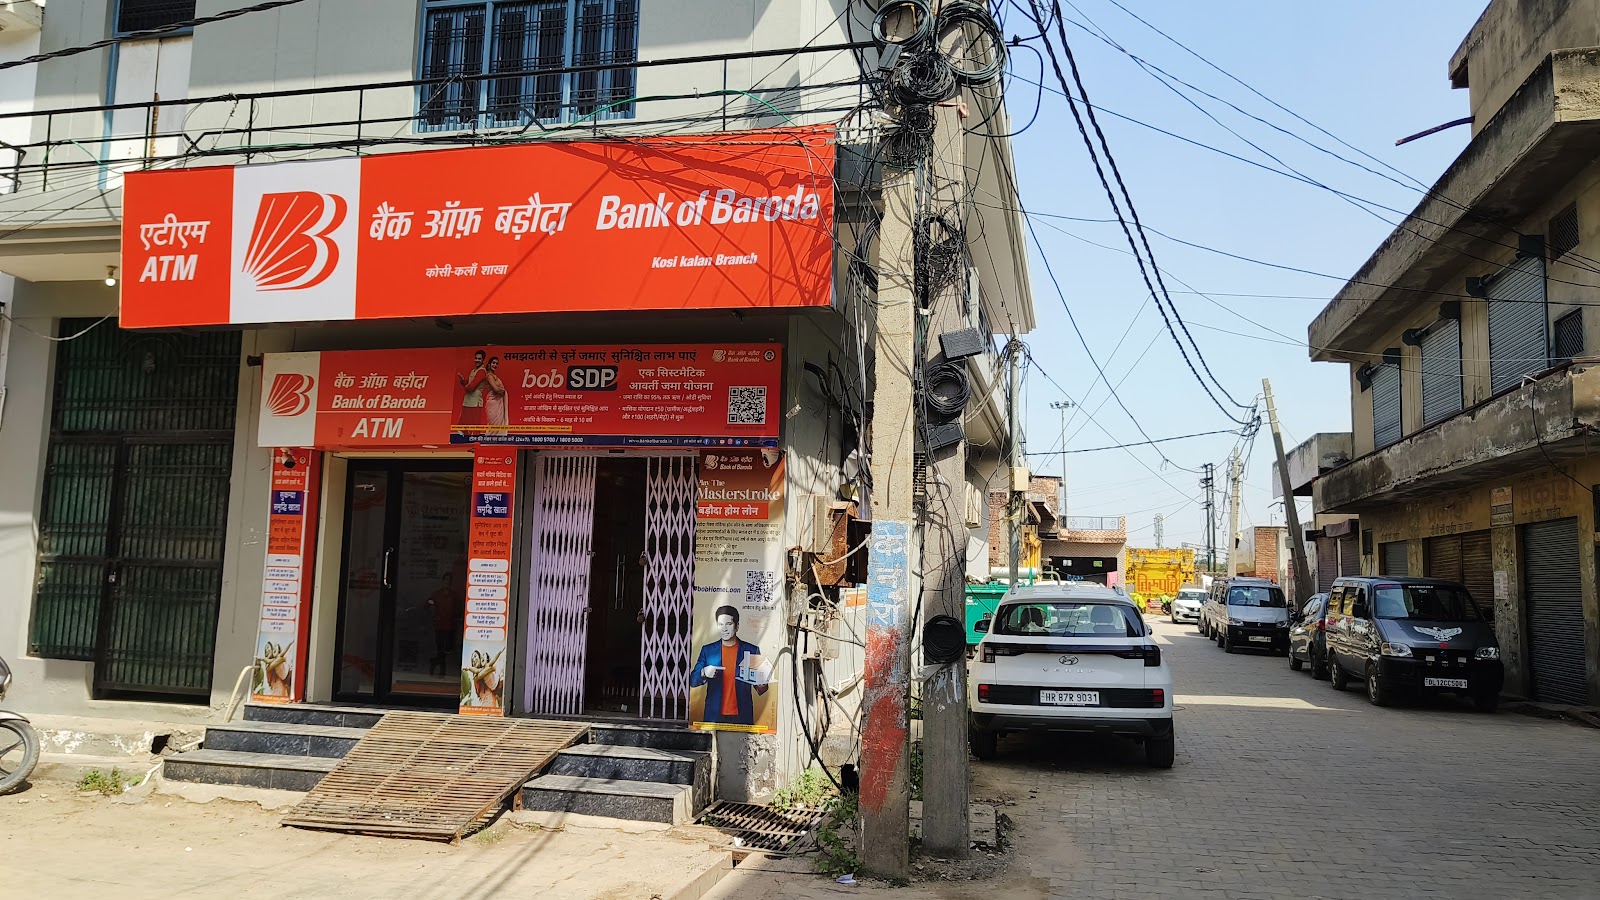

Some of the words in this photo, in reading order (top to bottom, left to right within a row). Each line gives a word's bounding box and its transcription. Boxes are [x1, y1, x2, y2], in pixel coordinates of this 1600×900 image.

[595, 192, 674, 231] Bank
[676, 190, 709, 227] of
[710, 184, 821, 226] Baroda
[369, 201, 415, 241] बैंक
[494, 192, 573, 241] बड़ौदा
[140, 213, 211, 251] एटीएम
[139, 254, 199, 283] ATM
[651, 256, 677, 269] Kosi
[679, 255, 712, 268] kalan
[715, 252, 758, 267] Branch
[480, 264, 509, 277] शाखा
[503, 350, 546, 362] समझदारी
[549, 349, 557, 361] से
[561, 349, 577, 363] चुनें
[611, 350, 651, 363] सुनिश्चित
[653, 350, 676, 361] लाभ
[334, 371, 355, 388] बैंक
[393, 371, 429, 391] बड़ौदा
[521, 368, 565, 388] bob
[569, 368, 616, 388] SDP
[638, 367, 655, 379] एक
[657, 366, 706, 378] सिस्टमेटिक
[629, 379, 660, 391] आवर्ती
[660, 381, 682, 391] जमा
[683, 379, 714, 391] योजना
[331, 394, 363, 409] Bank
[366, 394, 381, 409] of
[380, 394, 427, 409] Baroda
[351, 417, 404, 439] ATM
[698, 504, 722, 517] बड़ौदा
[724, 504, 740, 517] होम
[741, 504, 759, 516] लोन
[1045, 692, 1056, 702] HR
[1058, 693, 1074, 702] 87R
[1076, 693, 1097, 702] 9031
